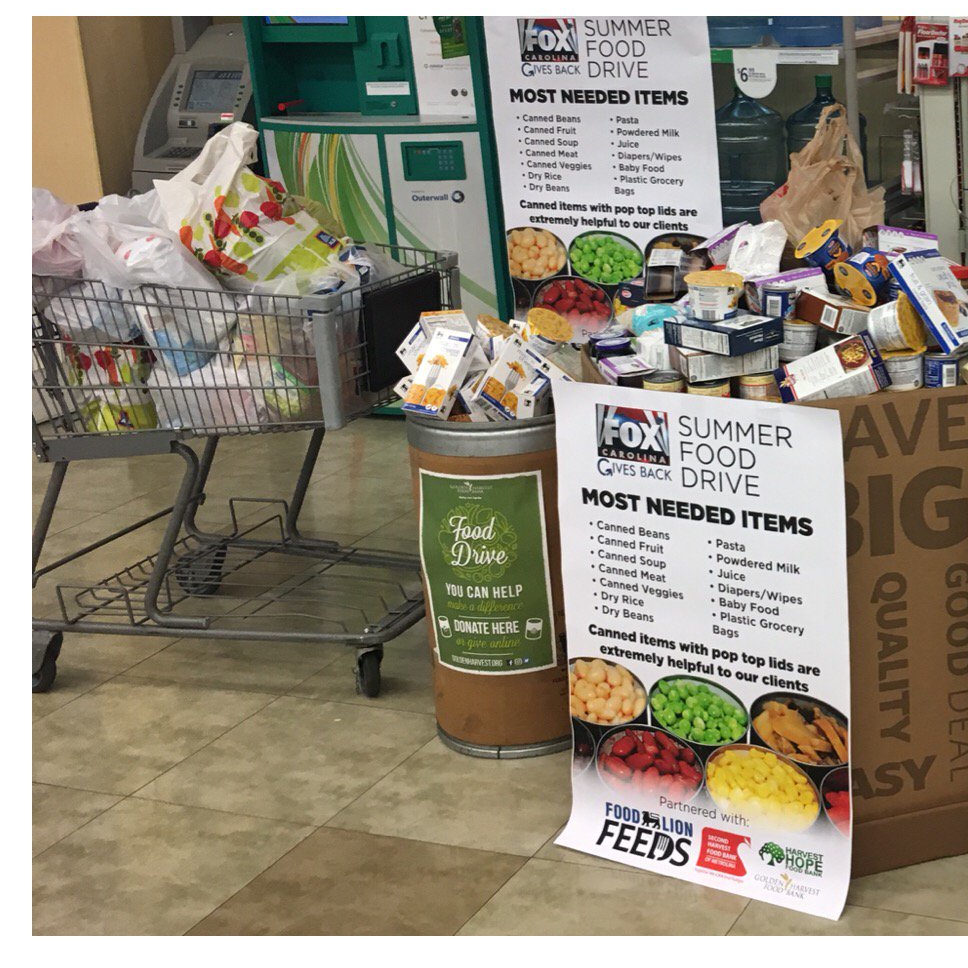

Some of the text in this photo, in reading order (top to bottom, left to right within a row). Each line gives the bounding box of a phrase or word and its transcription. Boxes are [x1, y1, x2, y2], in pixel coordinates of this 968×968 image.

[584, 19, 672, 37] SUMMER
[586, 40, 646, 57] FOOD
[588, 61, 649, 78] DRIVE
[510, 89, 688, 105] MOST NEEDED ITEMS
[411, 193, 449, 202] Outerwall
[449, 516, 496, 541] Food
[451, 540, 509, 566] Drive
[445, 582, 522, 599] YOU CAN HELP
[454, 619, 520, 634] DONATE HERE
[467, 637, 486, 650] give
[870, 571, 911, 744] QUALITY
[853, 754, 937, 800] ASY
[606, 802, 693, 837] FOOD LION
[660, 796, 750, 827] Partnered with:
[596, 819, 692, 867] FEEDS
[707, 841, 730, 852] HARVEST
[786, 847, 823, 860] HARVEST
[785, 853, 823, 873] HOPE
